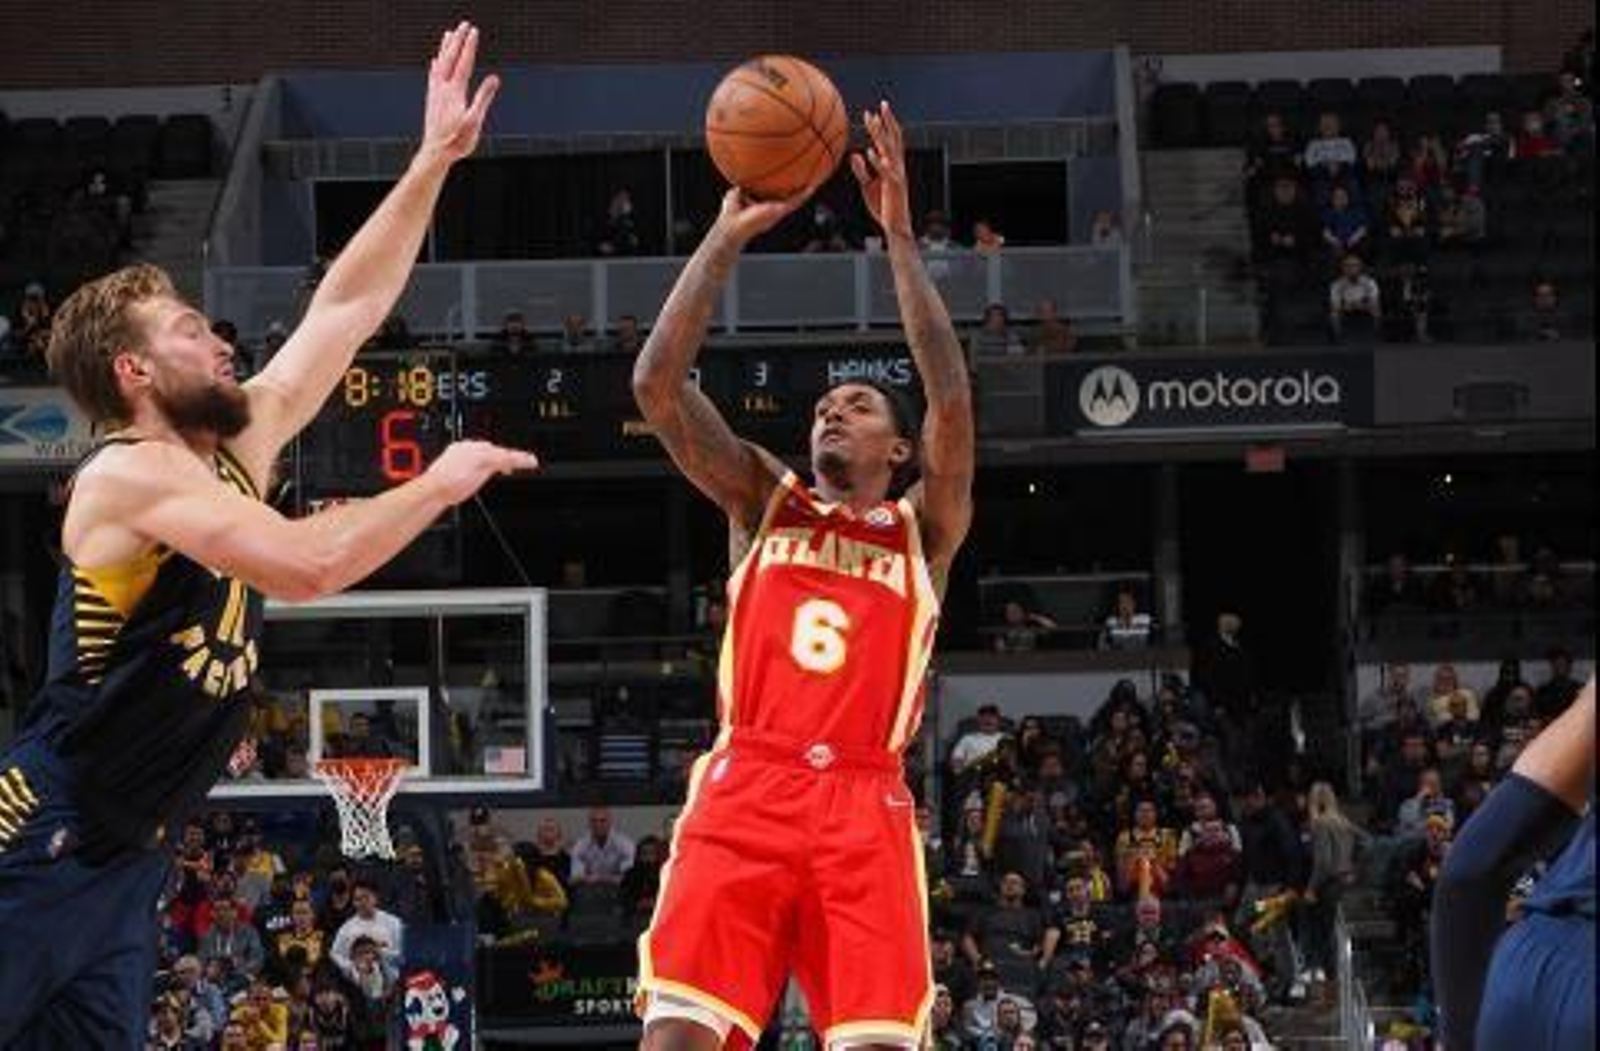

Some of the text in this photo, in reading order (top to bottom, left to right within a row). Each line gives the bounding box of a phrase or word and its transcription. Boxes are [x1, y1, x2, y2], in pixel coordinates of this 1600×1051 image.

[546, 368, 563, 393] 2
[1148, 369, 1340, 410] motorola
[381, 410, 422, 480] 6
[790, 597, 851, 675] 6
